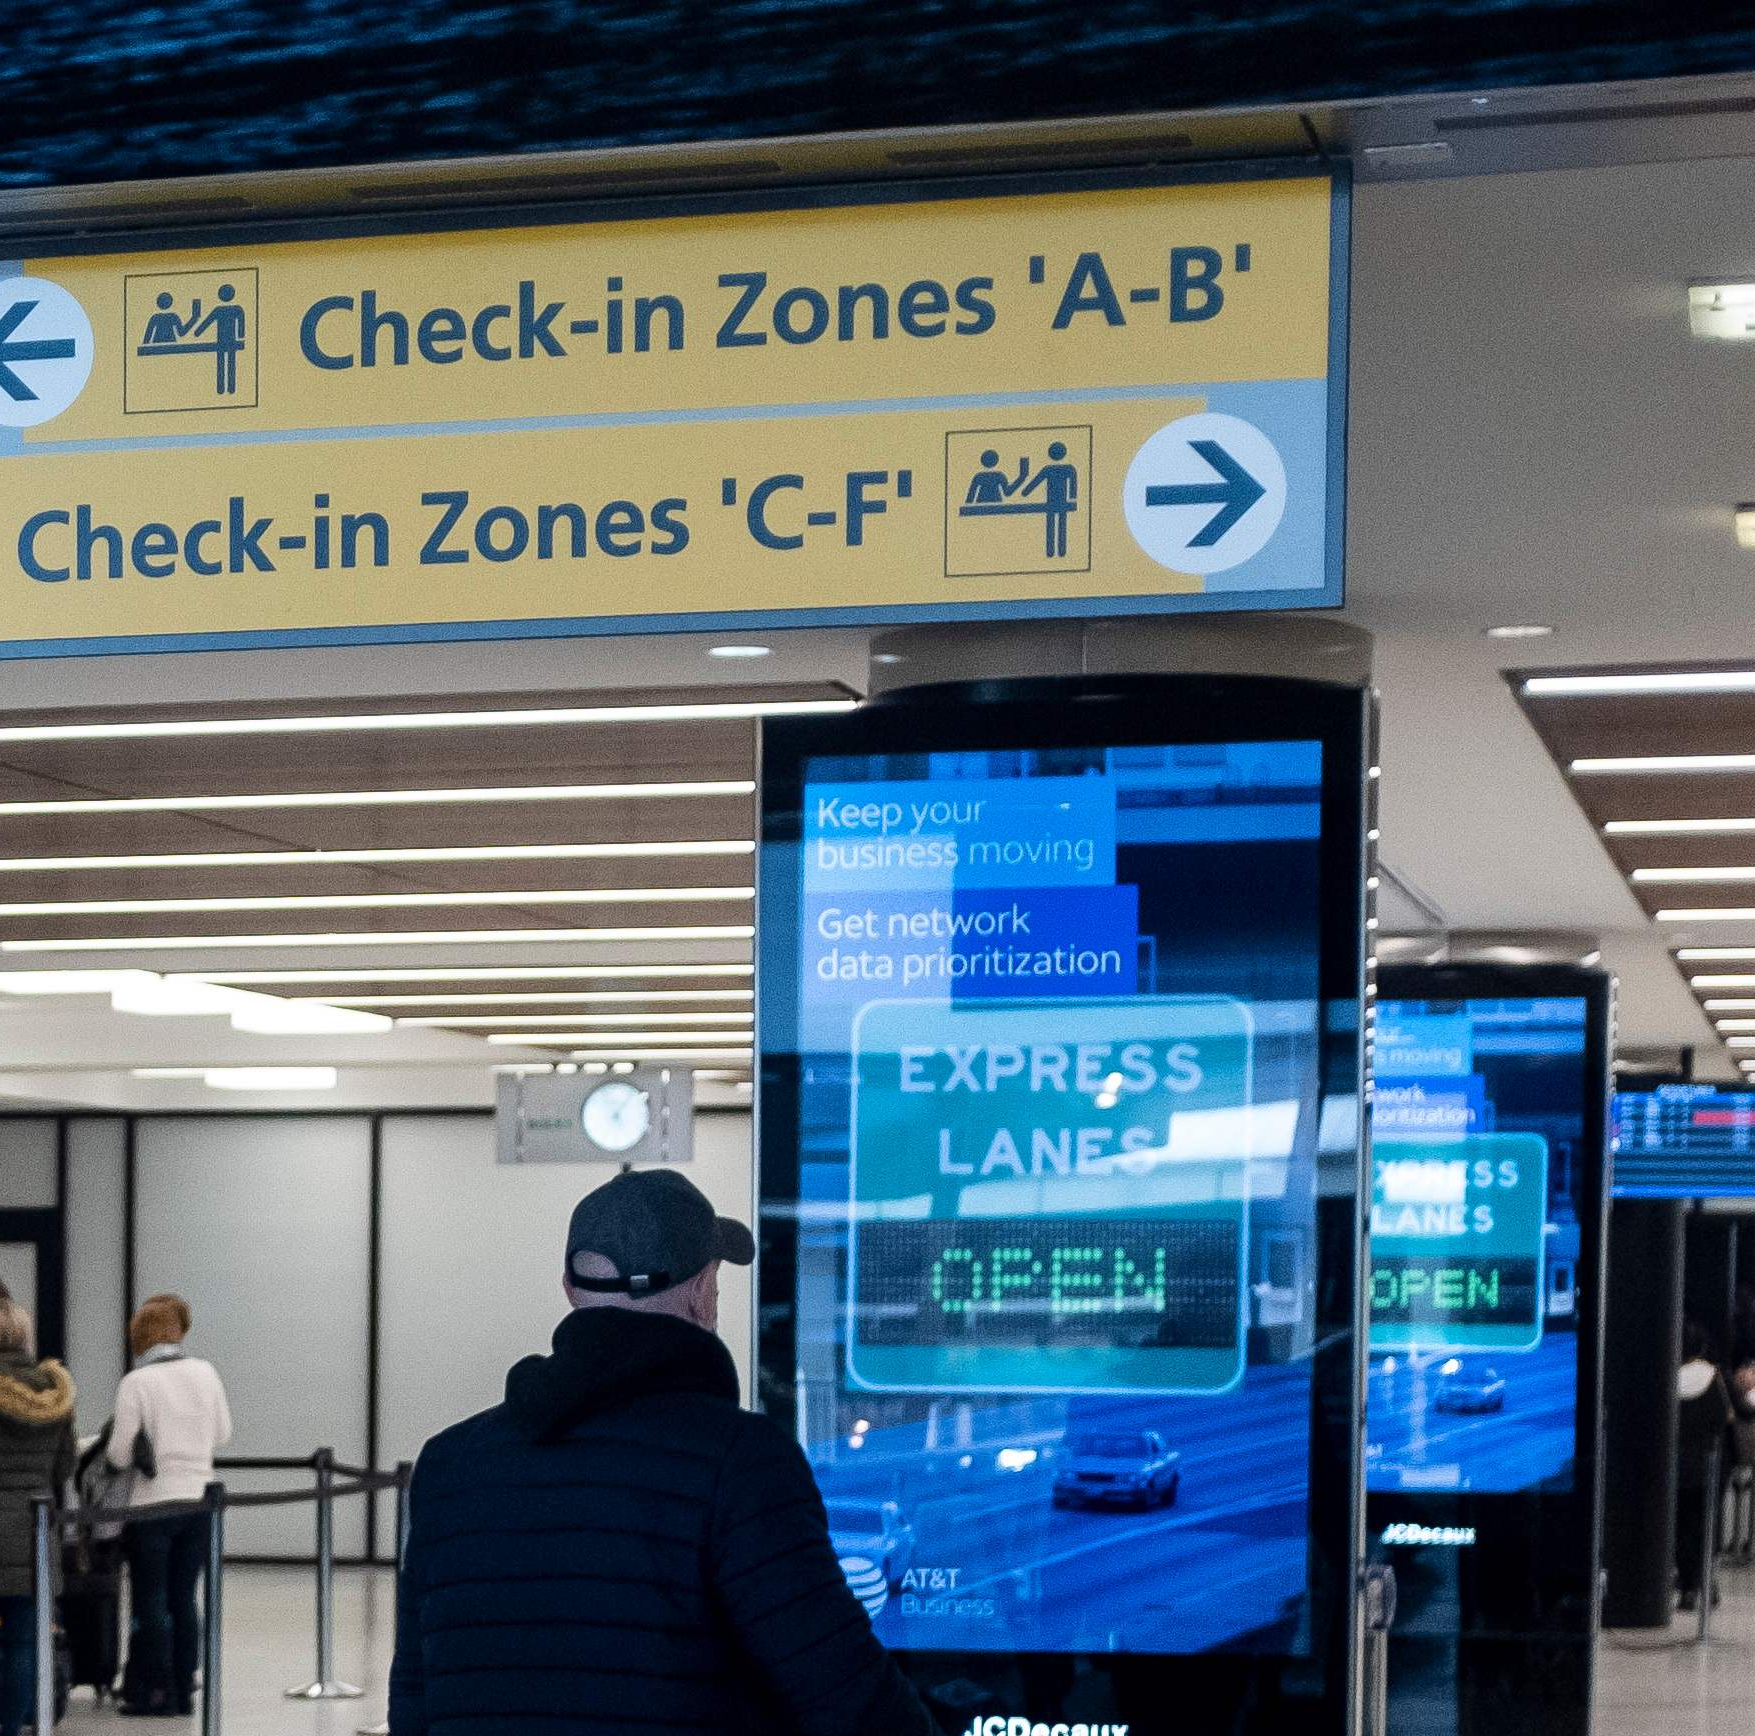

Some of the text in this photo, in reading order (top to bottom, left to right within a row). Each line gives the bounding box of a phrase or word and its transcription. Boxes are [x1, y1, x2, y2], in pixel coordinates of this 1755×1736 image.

[299, 243, 1251, 371] Check-in Zones 'A-B'
[17, 469, 913, 583] Check-in Zones 'C-F'
[816, 797, 987, 836] Keep your
[816, 832, 1095, 872] business moving
[816, 903, 1031, 940] Get network
[816, 944, 1121, 987] data prioritization
[898, 1043, 1205, 1094] EXPRESS
[938, 1126, 1157, 1175] LANES
[1371, 1204, 1495, 1235] LANES
[931, 1247, 1167, 1314] OPEN
[1368, 1267, 1500, 1309] OPEN
[900, 1567, 961, 1591] AT&T
